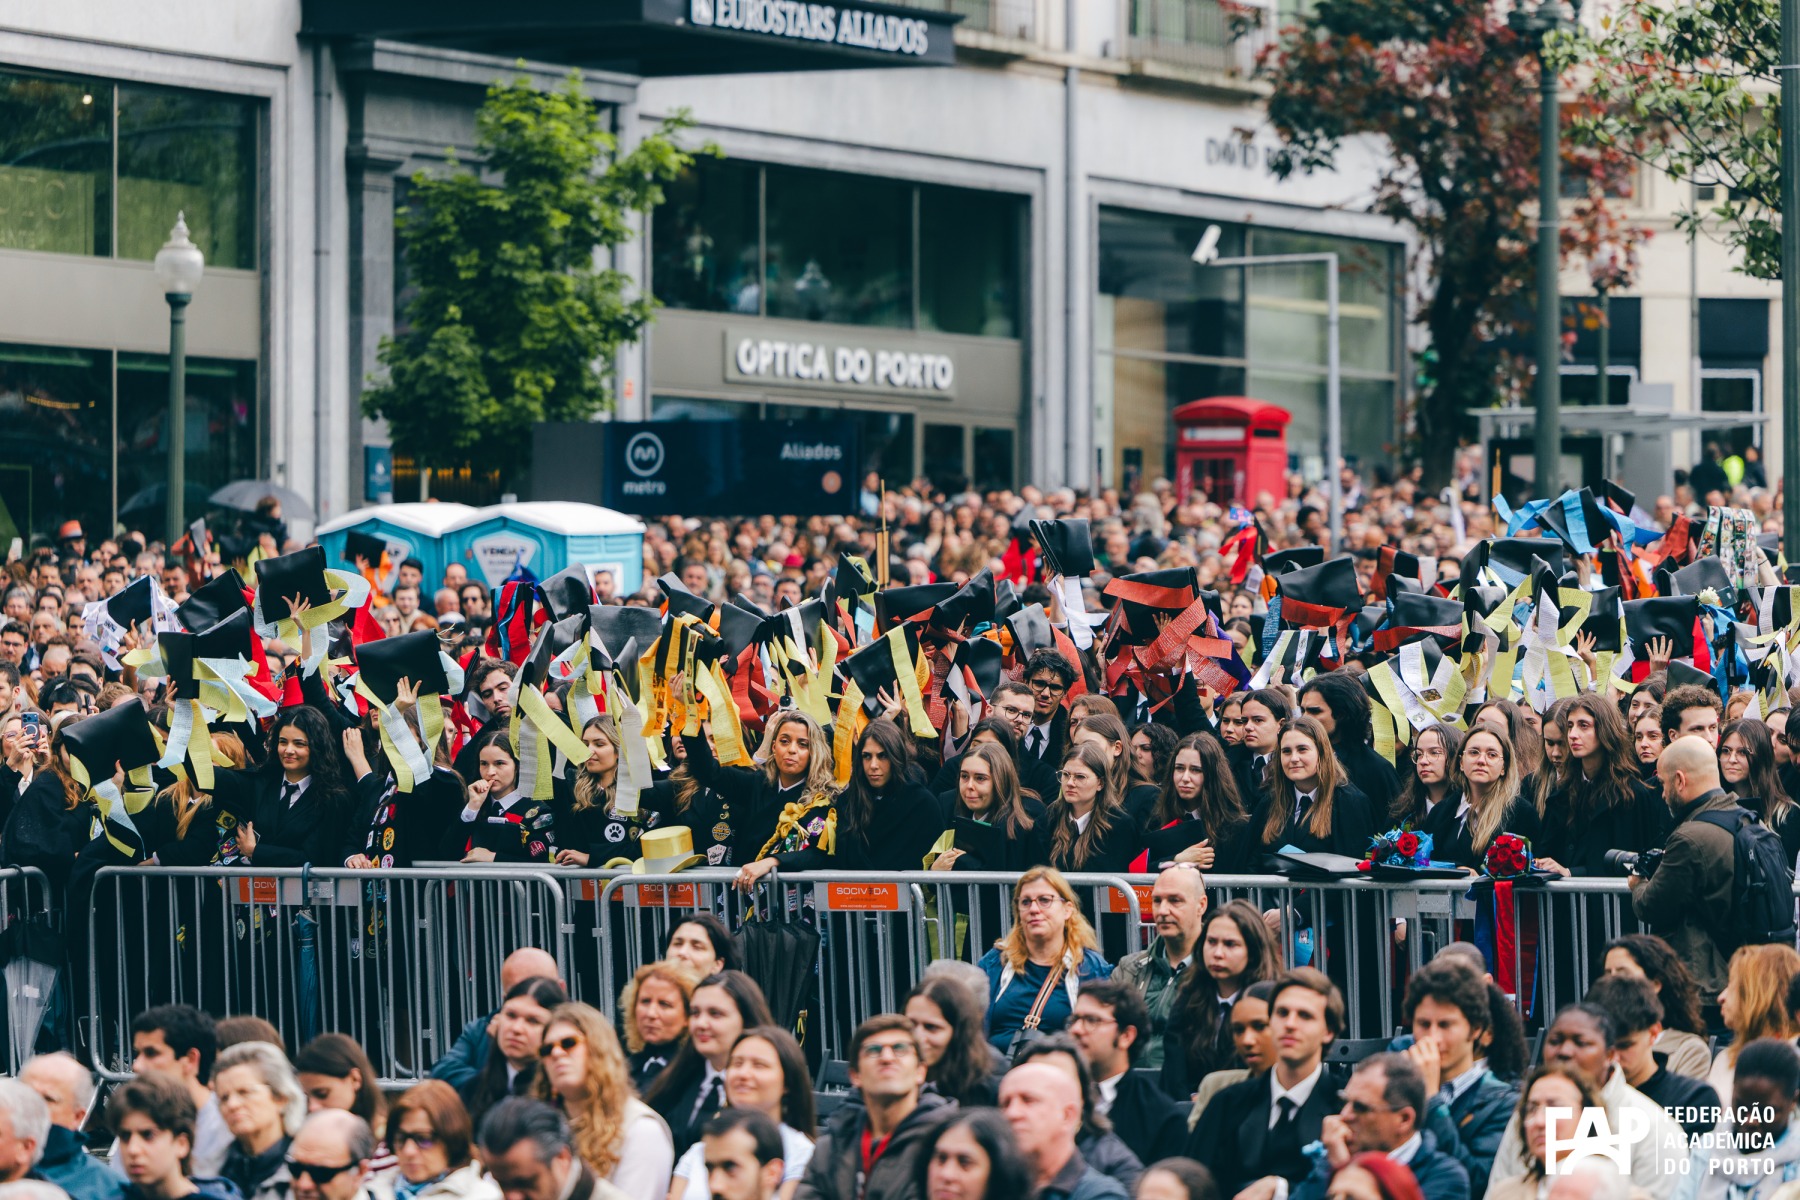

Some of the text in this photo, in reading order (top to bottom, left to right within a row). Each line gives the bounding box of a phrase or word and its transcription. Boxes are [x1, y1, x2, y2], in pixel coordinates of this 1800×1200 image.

[715, 0, 928, 55] EUROSTARS ALIADOS
[834, 347, 873, 384] DO
[875, 350, 954, 390] PORTO
[780, 442, 843, 460] Aliados
[622, 481, 667, 495] metro
